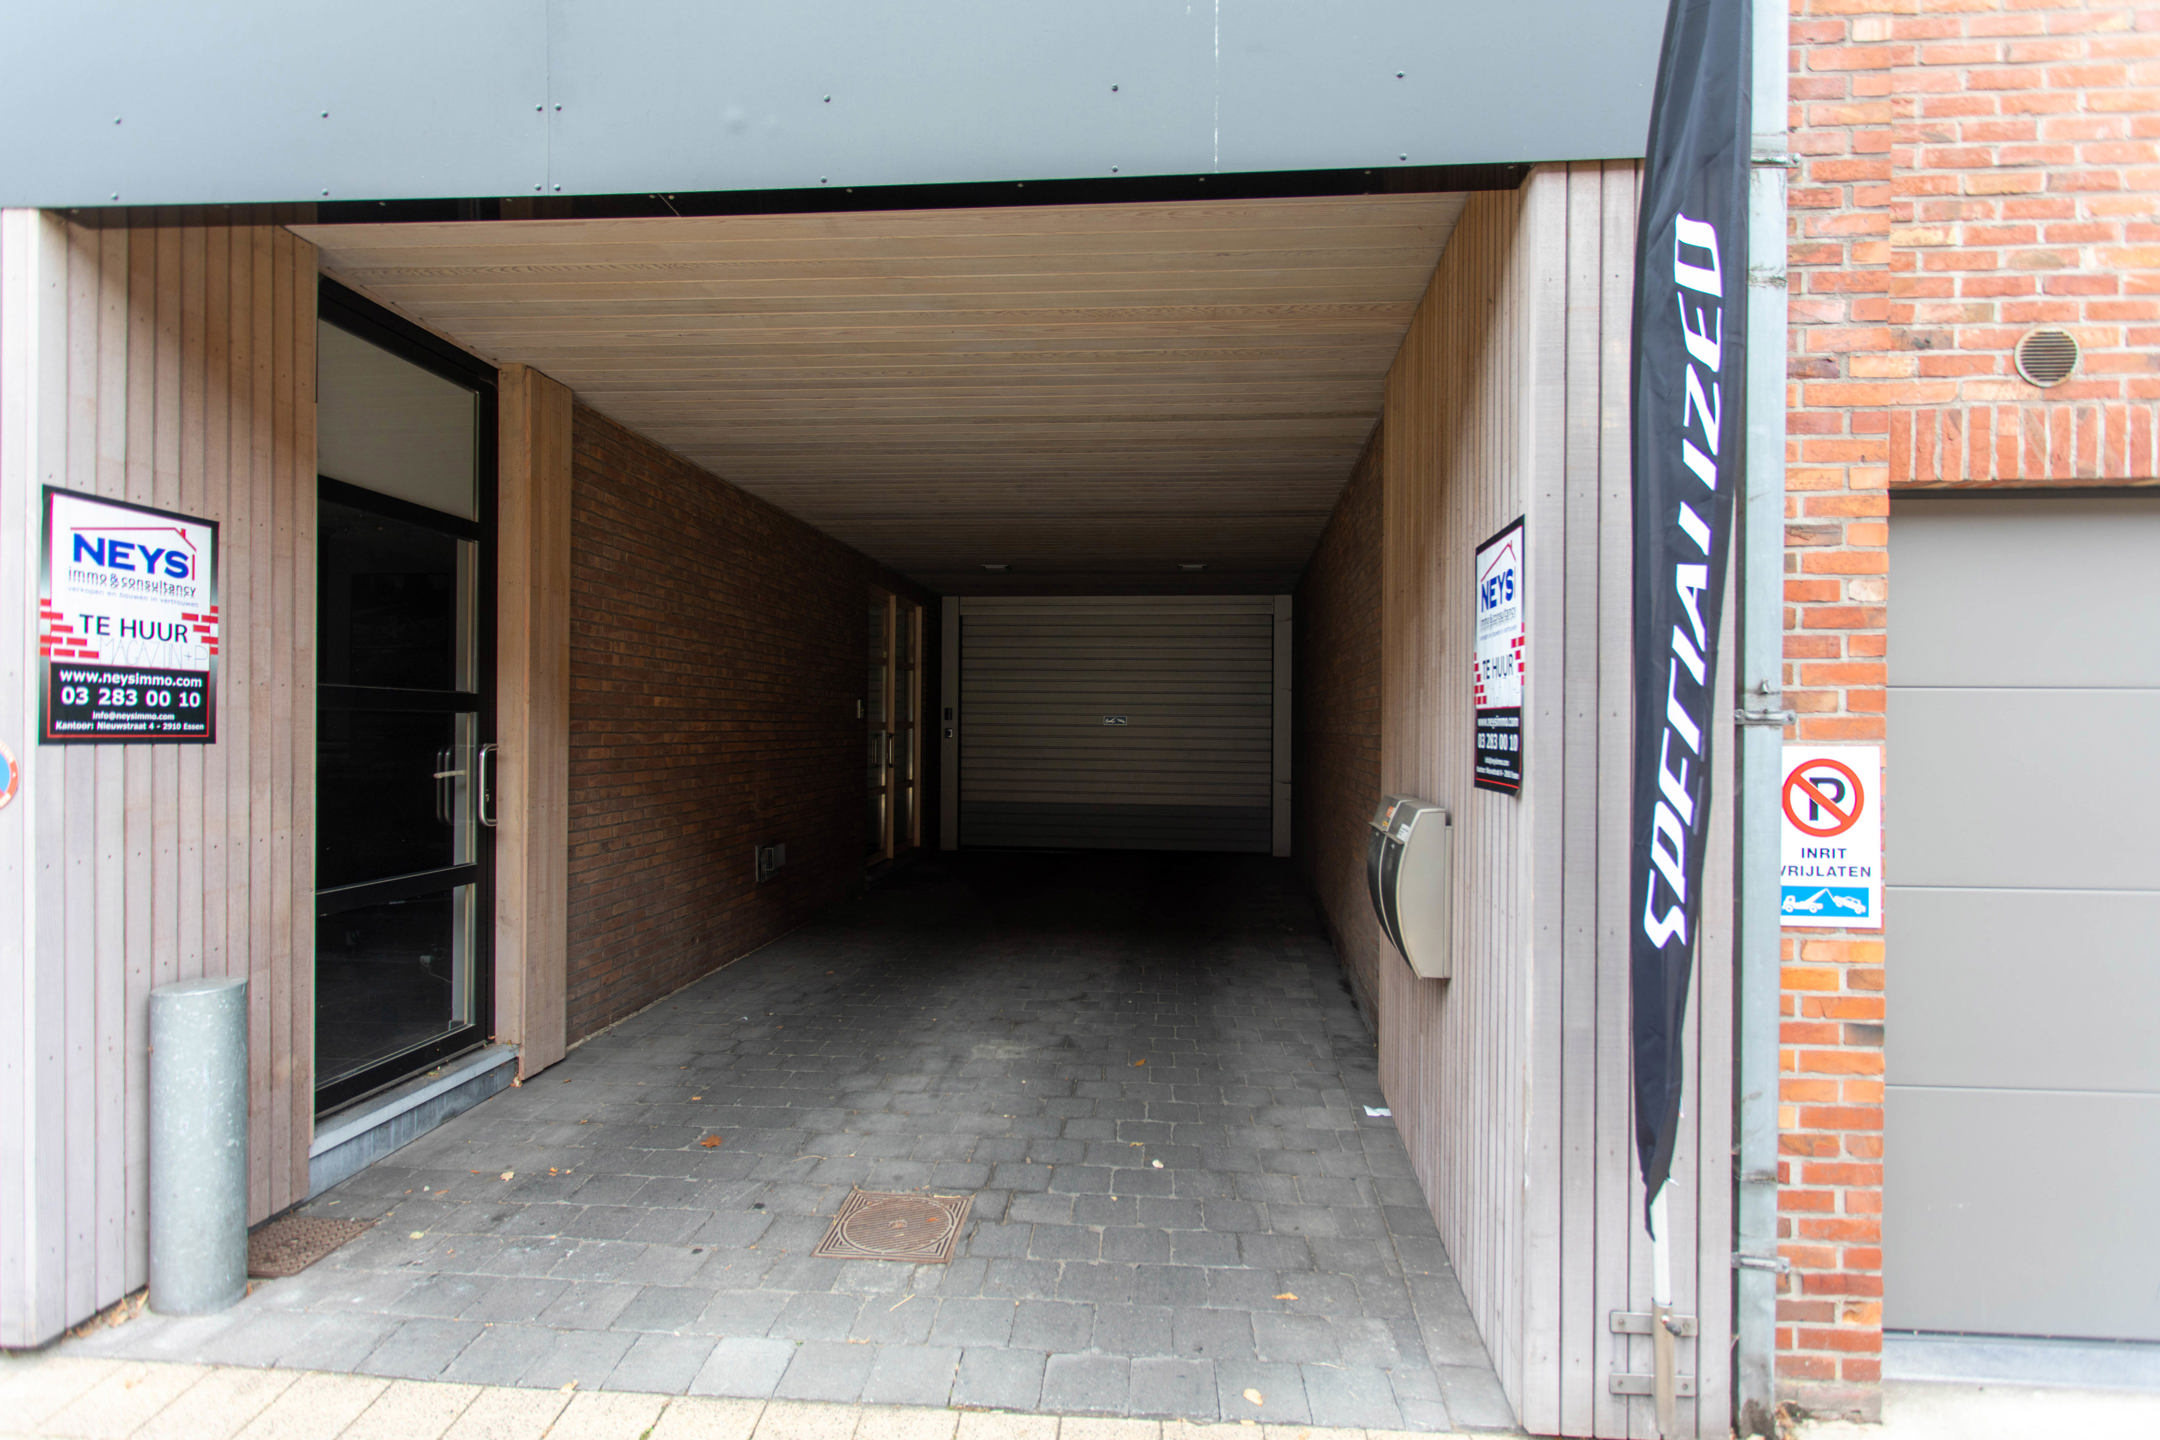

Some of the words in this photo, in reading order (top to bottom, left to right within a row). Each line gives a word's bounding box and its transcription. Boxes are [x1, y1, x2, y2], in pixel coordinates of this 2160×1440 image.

[73, 533, 190, 579] NEYS
[68, 567, 107, 584] immo
[121, 576, 197, 598] consultancy
[1481, 568, 1514, 613] NEYS
[79, 613, 111, 636] TE
[120, 617, 188, 643] HUUR
[59, 670, 203, 688] www.neysimmo.com
[1482, 659, 1491, 680] TE
[1492, 654, 1514, 679] HUUR
[60, 685, 90, 705] 03
[98, 687, 138, 706] 283
[145, 689, 171, 707] 00
[178, 691, 201, 708] 10
[55, 720, 94, 731] Kantoor:
[96, 721, 147, 731] Nieuwstraat
[162, 723, 181, 731] 2910
[183, 723, 205, 731] Essen
[92, 711, 175, 722] info@neysimmo.com
[1801, 848, 1847, 859] INRIT
